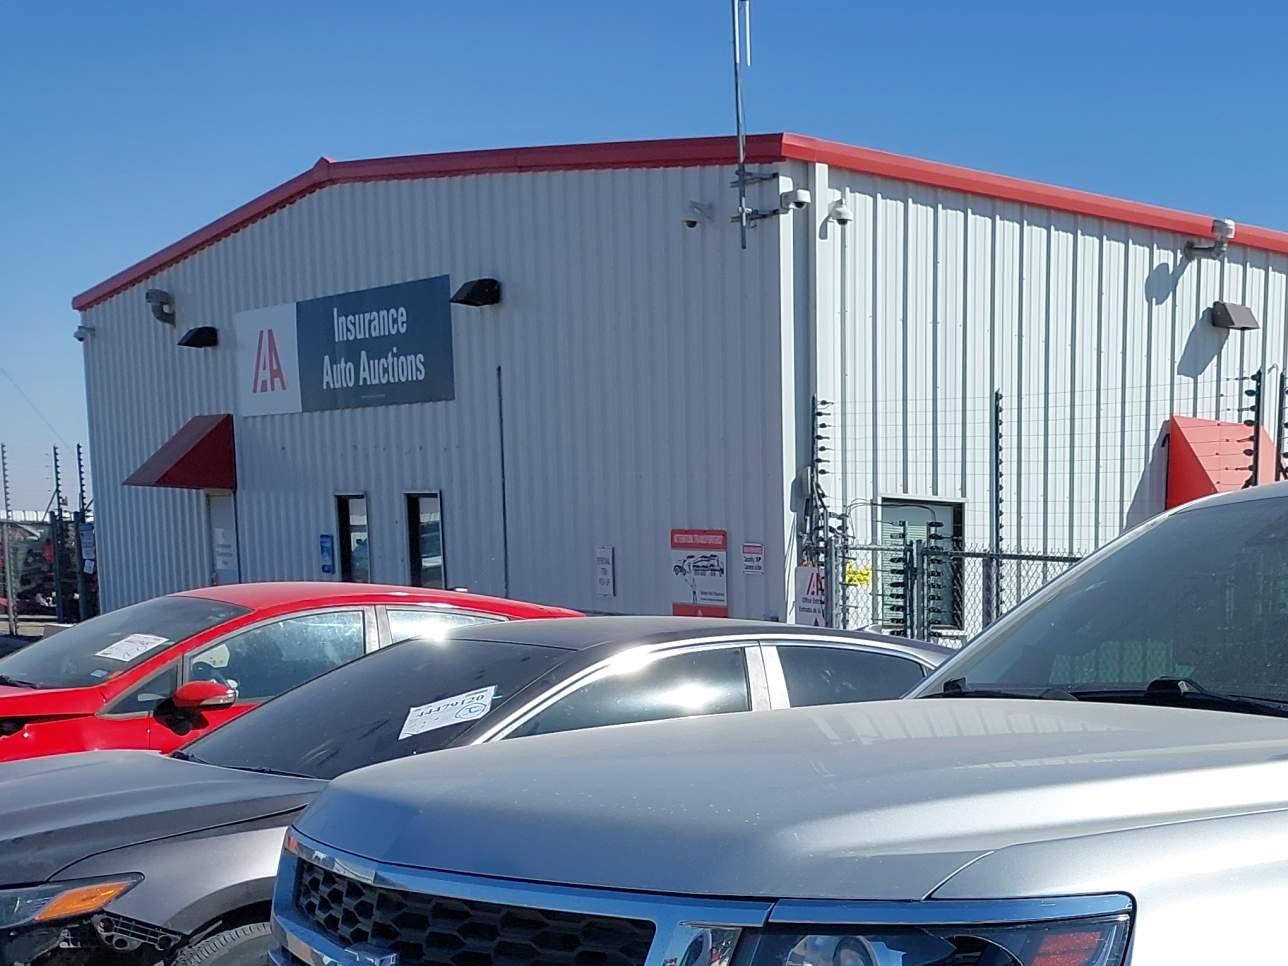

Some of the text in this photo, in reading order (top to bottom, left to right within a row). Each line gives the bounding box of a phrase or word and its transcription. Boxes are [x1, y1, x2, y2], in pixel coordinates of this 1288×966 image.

[333, 305, 407, 342] Insurance
[322, 346, 426, 390] Auto Auctions
